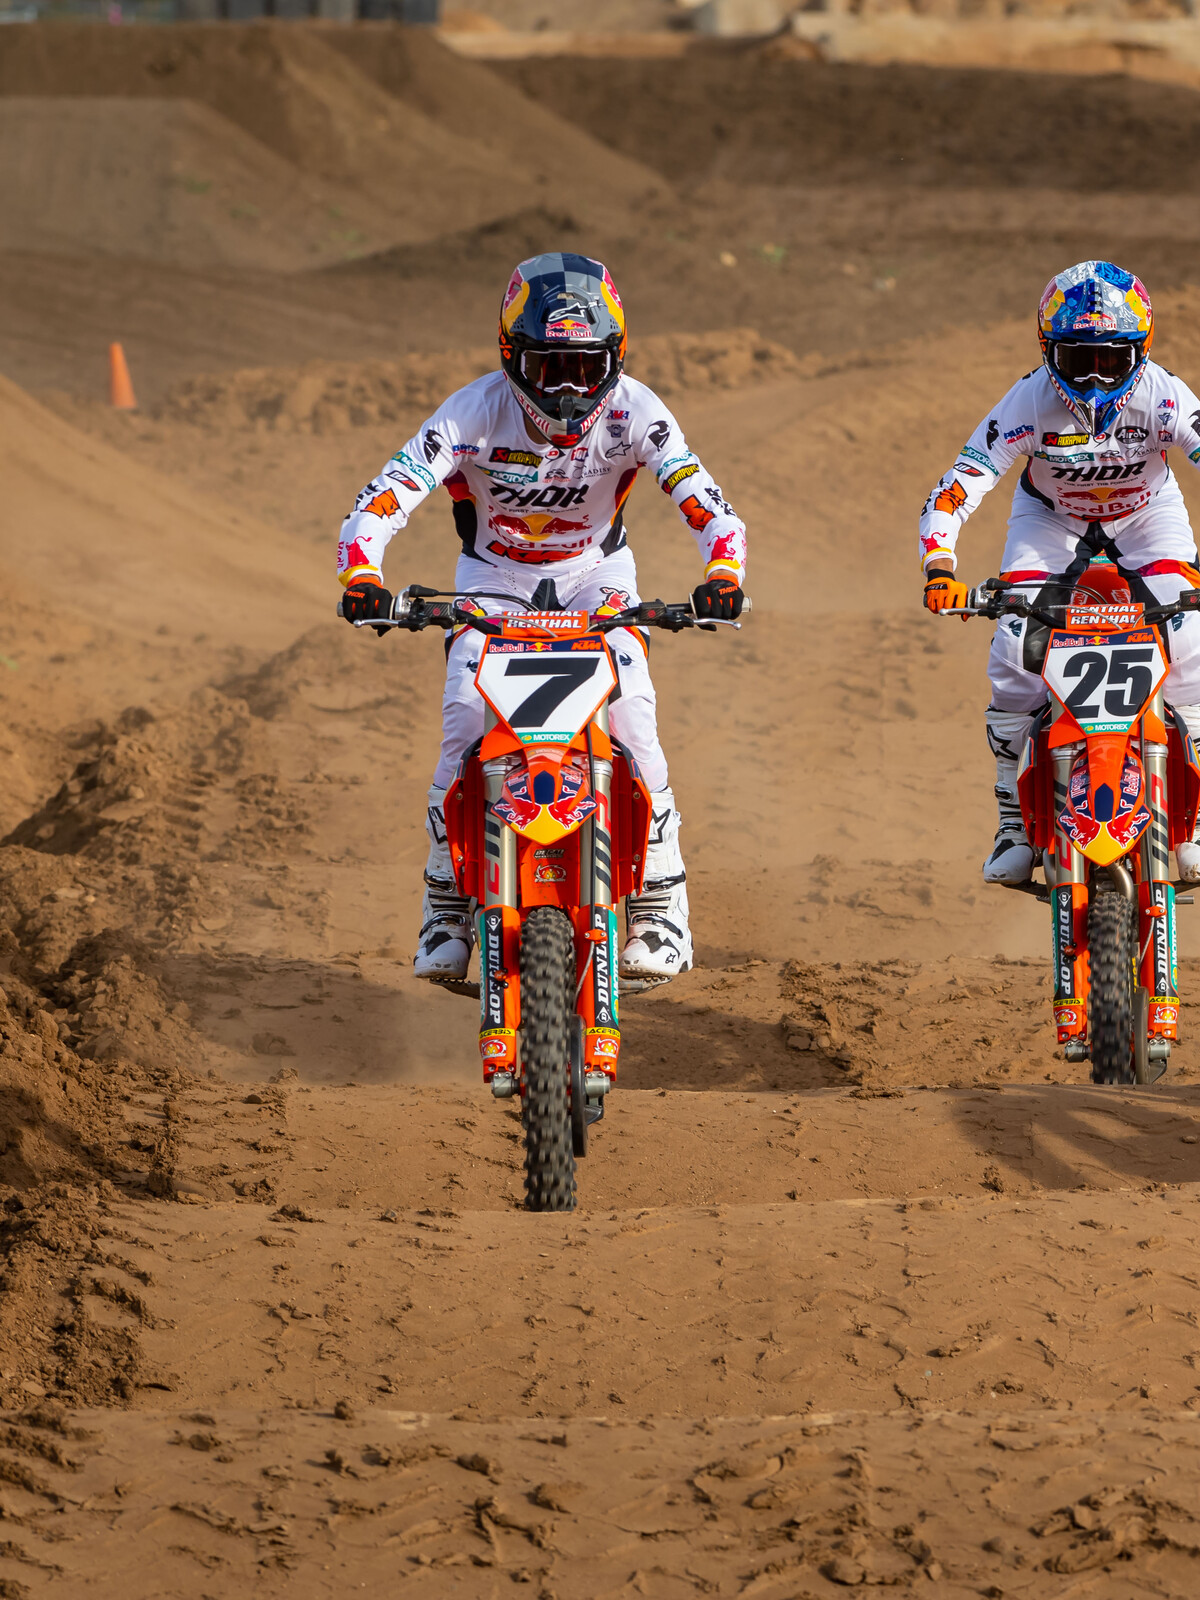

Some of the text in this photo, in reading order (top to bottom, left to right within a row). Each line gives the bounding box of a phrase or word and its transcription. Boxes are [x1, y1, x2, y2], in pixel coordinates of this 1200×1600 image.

[1074, 320, 1117, 329] Red Bull
[546, 330, 592, 338] Red Bull
[606, 410, 630, 420] AMA
[1004, 425, 1034, 440] PARTS
[1118, 428, 1146, 438] Airoh
[1048, 454, 1090, 462] MOTOREX
[1051, 461, 1147, 482] THOR
[489, 483, 590, 508] THOR
[1058, 498, 1104, 514] Red
[1109, 491, 1152, 512] Bull
[507, 619, 582, 628] RENTHAL
[1070, 614, 1136, 624] RENTHAL
[1053, 637, 1084, 647] Red Bull
[1126, 632, 1154, 643] KTM
[490, 644, 524, 652] Red Bull
[571, 640, 602, 650] KTM
[1063, 648, 1154, 719] 25
[504, 657, 602, 728] 7
[1156, 889, 1167, 975] DUNLP
[594, 913, 609, 1006] DUNLP
